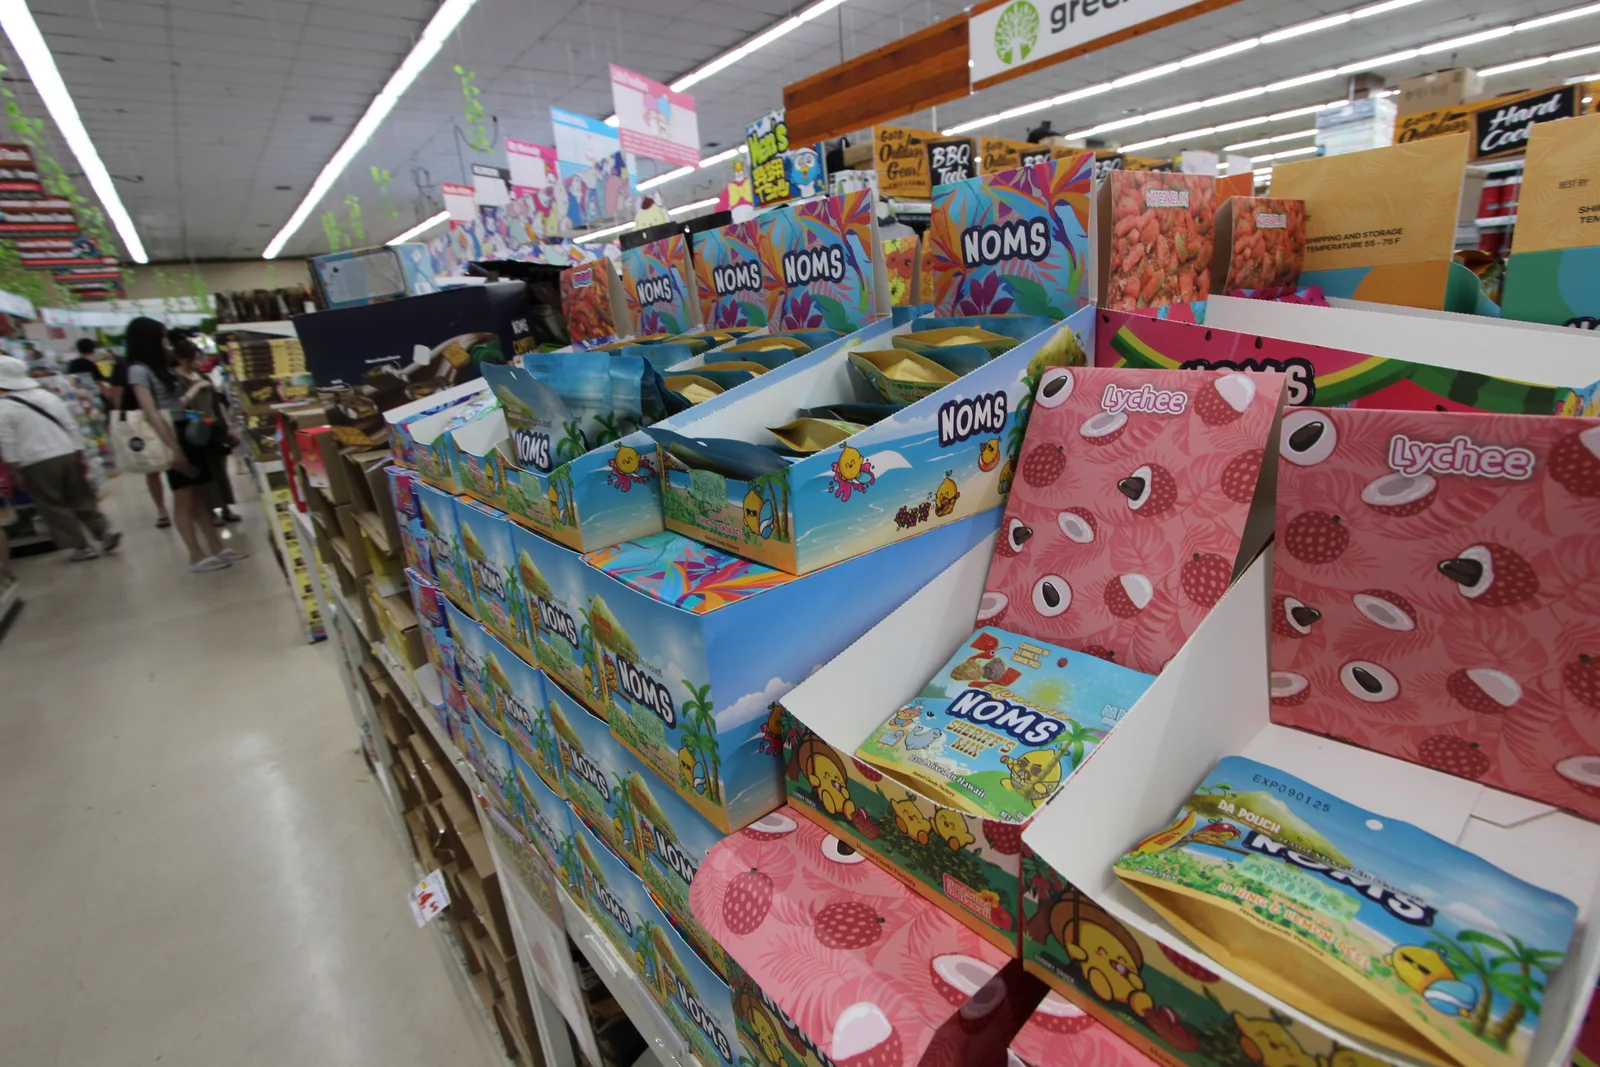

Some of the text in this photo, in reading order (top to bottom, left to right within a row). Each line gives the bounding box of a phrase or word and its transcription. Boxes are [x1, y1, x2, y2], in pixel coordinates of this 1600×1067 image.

[932, 144, 970, 168] BBQ
[964, 221, 1048, 264] NOMS
[1305, 227, 1404, 244] SHIPPING AND STORAGE
[1306, 241, 1363, 253] TEMPERATURE
[713, 263, 761, 294] NOMS
[784, 249, 845, 283] NOMS
[636, 276, 673, 304] NOMS
[1101, 384, 1188, 416] Lychee
[940, 395, 1006, 443] NOMS
[516, 432, 549, 469] NOMS
[1388, 434, 1535, 481] Lychee
[480, 563, 505, 600] NOMS
[539, 603, 579, 649] NOMS
[617, 658, 674, 726] NOMS
[505, 699, 533, 735] NOMS
[950, 691, 1060, 744] NOMS
[1101, 704, 1118, 718] DA
[945, 719, 1018, 754] SHERIFF'S
[949, 737, 986, 758] MIX
[570, 749, 609, 799] NOMS
[924, 759, 949, 779] Mixed
[947, 770, 957, 782] in
[955, 777, 988, 799] Hawaii
[1251, 773, 1331, 813] EXP090125
[1218, 799, 1236, 814] DA
[1237, 807, 1282, 834] POUCH
[655, 830, 697, 884] NOM
[593, 877, 631, 936] NOMS
[1217, 881, 1233, 893] LI
[1232, 887, 1269, 909] HING
[1268, 902, 1282, 916] &
[1283, 909, 1335, 944] LEMON
[1335, 938, 1372, 970] PEEL
[677, 980, 731, 1062] NOMS
